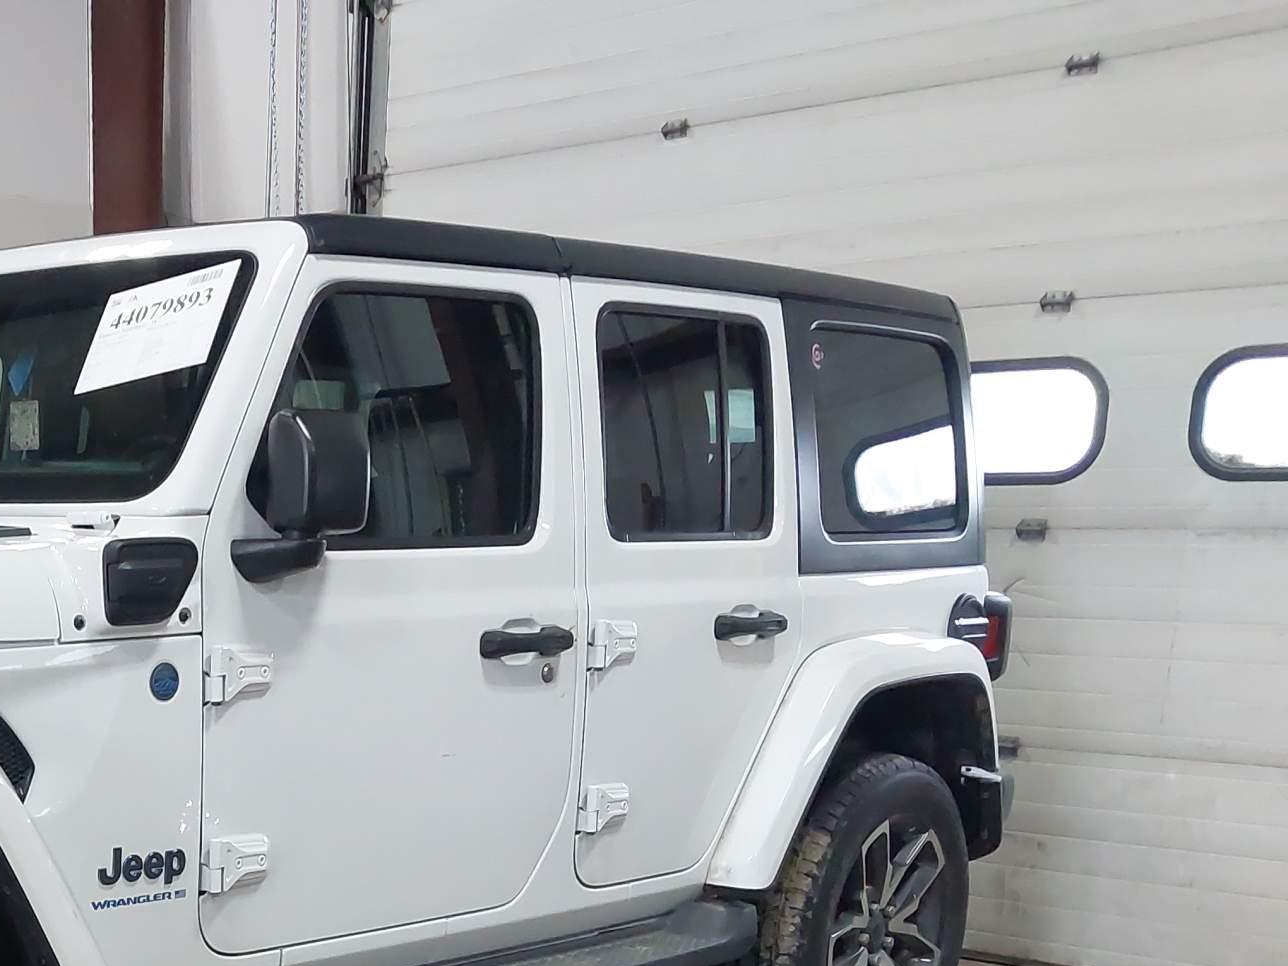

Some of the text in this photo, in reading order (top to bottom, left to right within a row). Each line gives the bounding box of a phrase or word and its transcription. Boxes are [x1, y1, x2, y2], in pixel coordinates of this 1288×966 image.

[109, 286, 215, 330] 44079893
[97, 846, 186, 885] Jeep
[90, 890, 173, 911] WRANGLER
